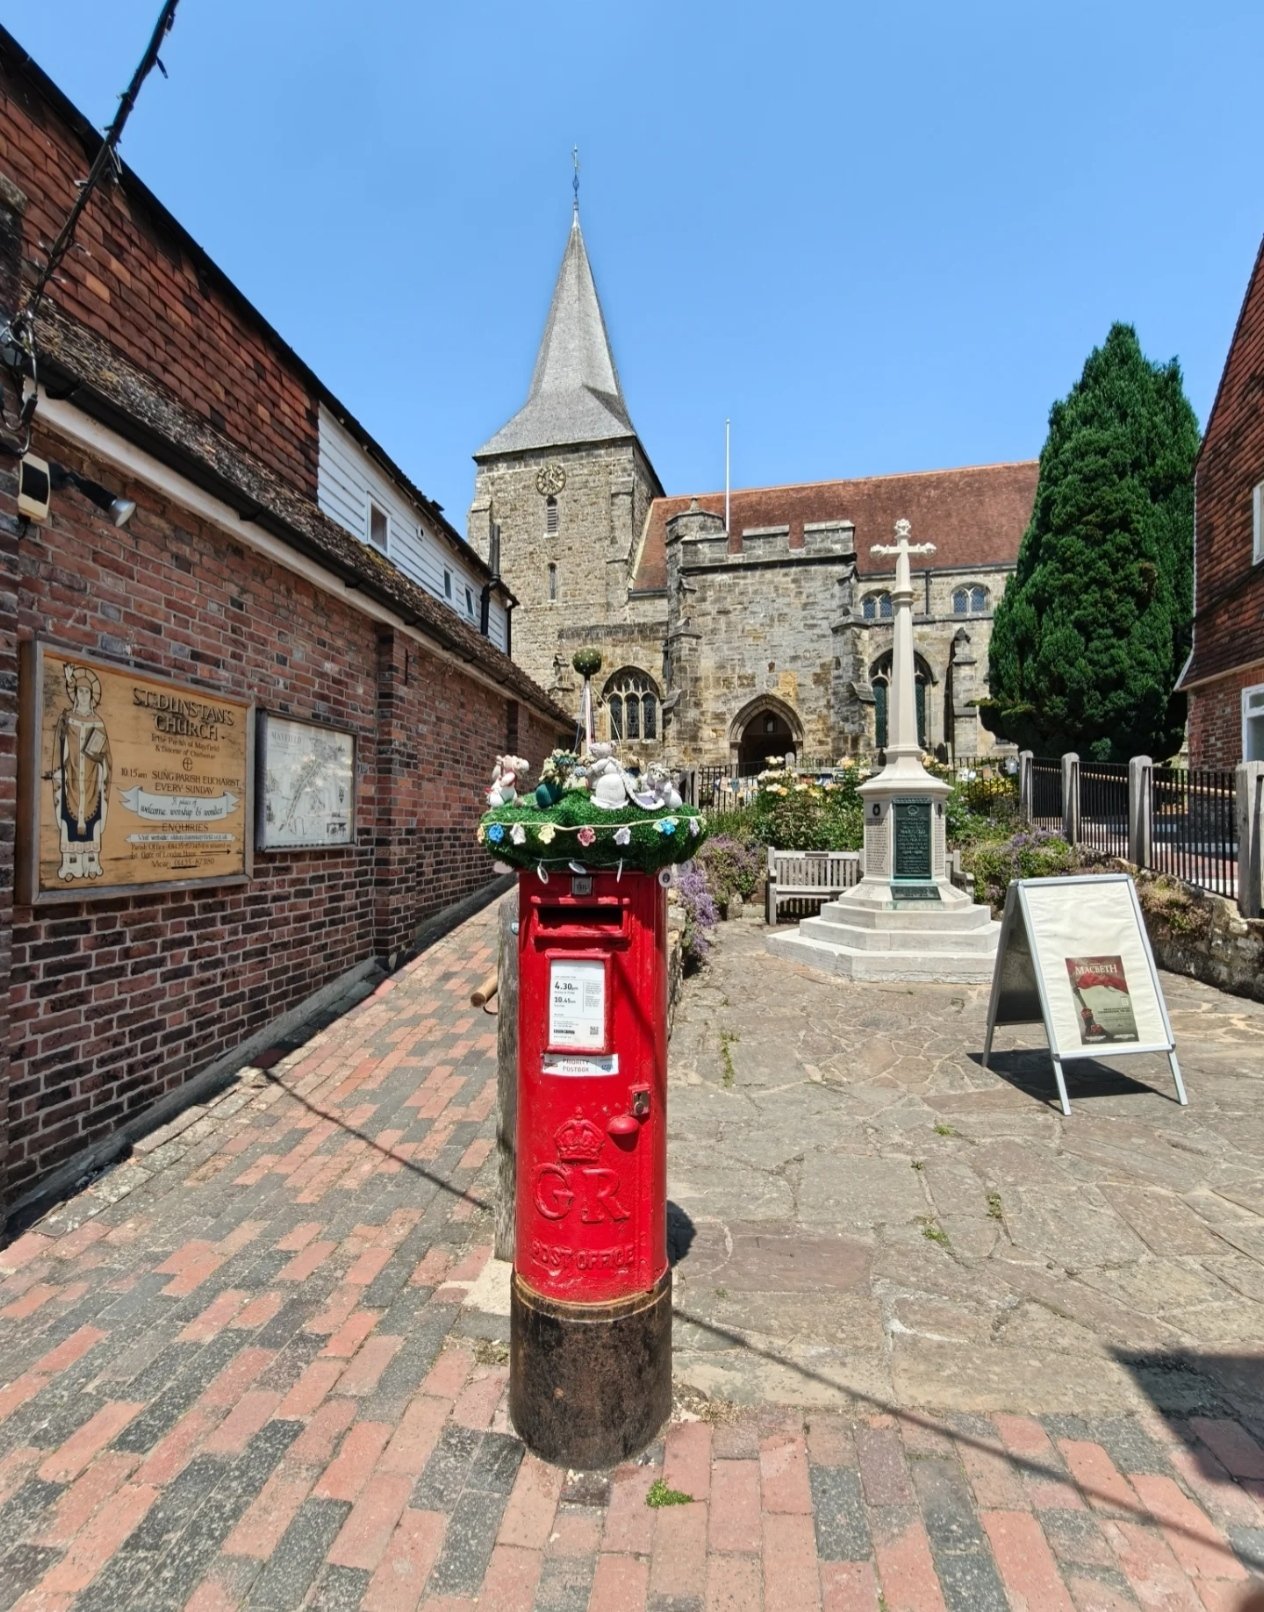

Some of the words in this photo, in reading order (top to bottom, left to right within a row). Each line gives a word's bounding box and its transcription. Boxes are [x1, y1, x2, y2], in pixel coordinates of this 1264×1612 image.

[155, 714, 218, 741] CHURCH
[152, 771, 174, 781] SUNG
[176, 774, 201, 784] PARISH
[203, 775, 240, 788] EUCHARIST
[155, 782, 183, 792] EVERY
[185, 784, 215, 795] SUNDAY
[170, 806, 193, 819] worship
[204, 805, 223, 817] wonder
[162, 822, 209, 833] ENQUIRIES
[1075, 964, 1118, 975] MACBETH
[563, 1065, 590, 1073] POSTBOX
[531, 1239, 573, 1267] POST
[577, 1244, 635, 1270] OFFICE
